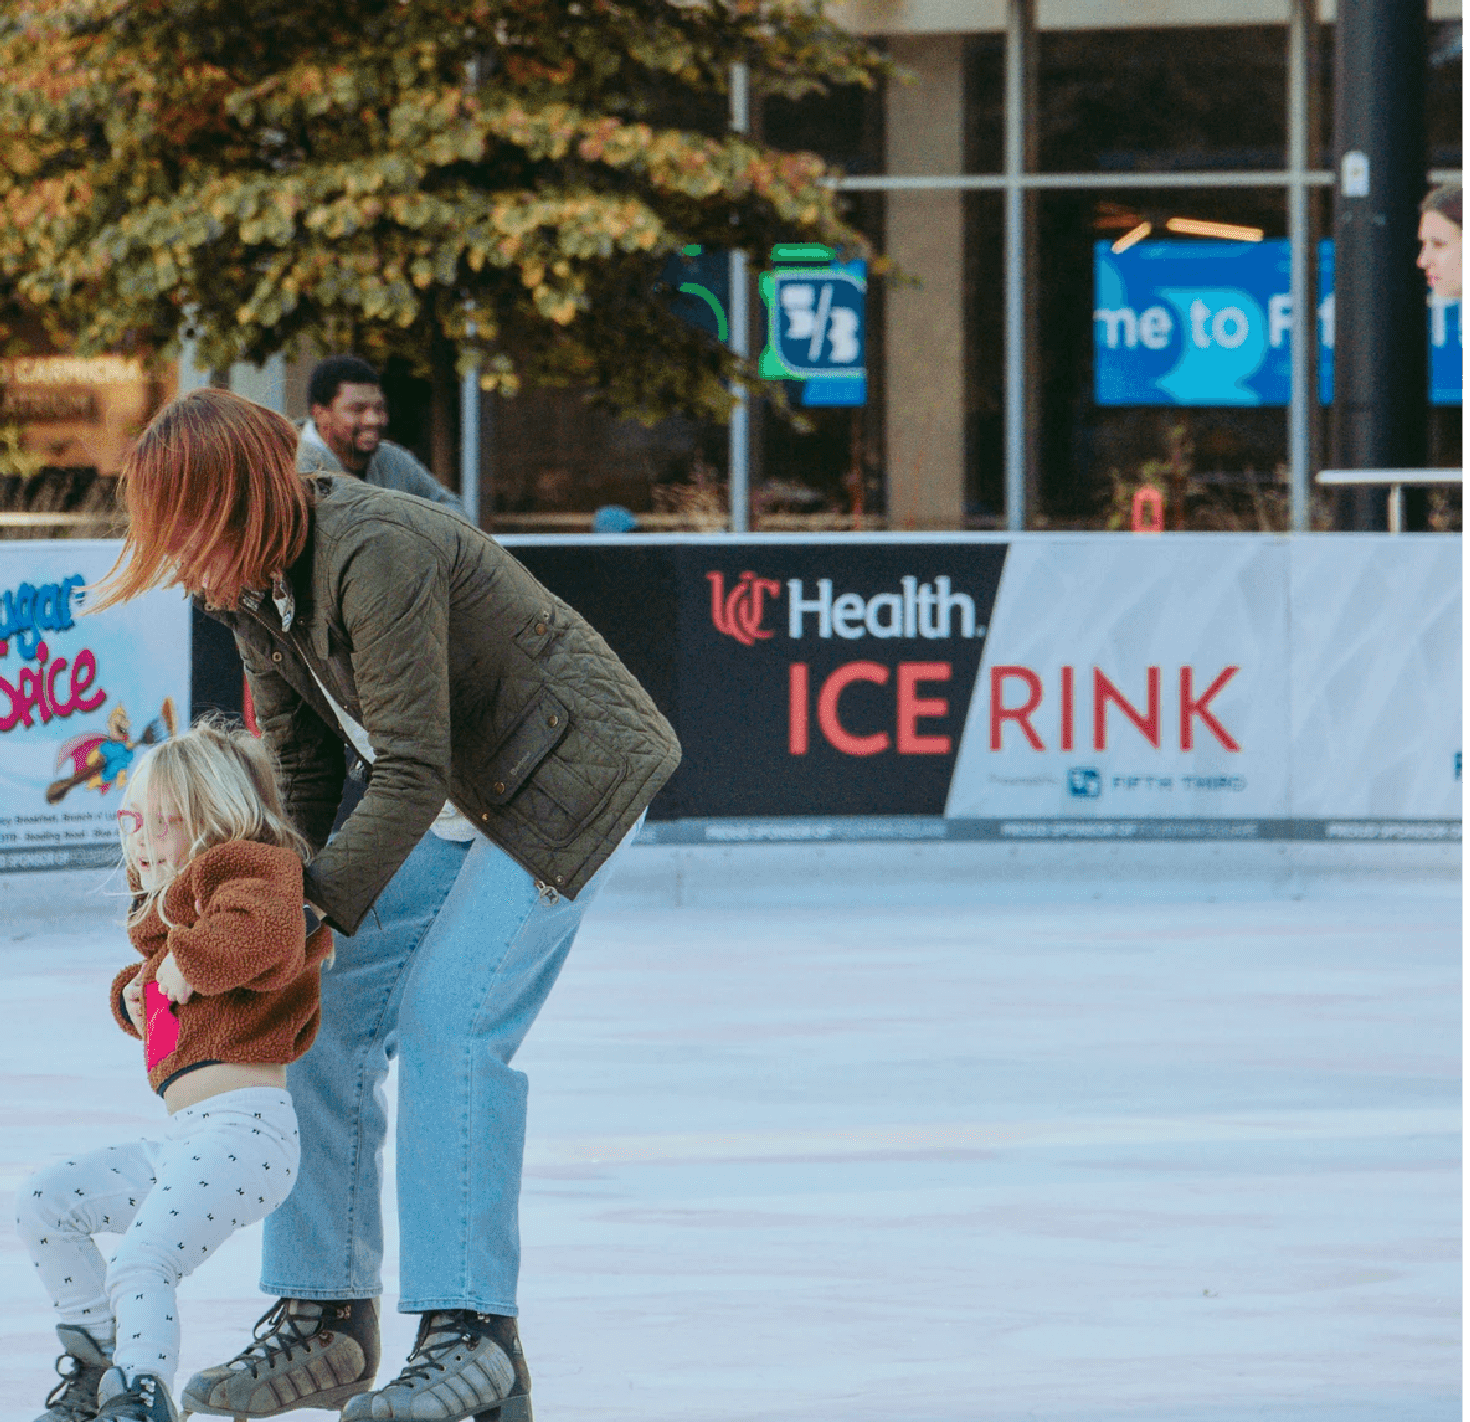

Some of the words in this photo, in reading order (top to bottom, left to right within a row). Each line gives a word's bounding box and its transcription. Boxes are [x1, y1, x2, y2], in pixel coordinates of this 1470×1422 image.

[1191, 297, 1249, 350] to
[789, 660, 954, 756] ICE
[989, 664, 1242, 754] RINK
